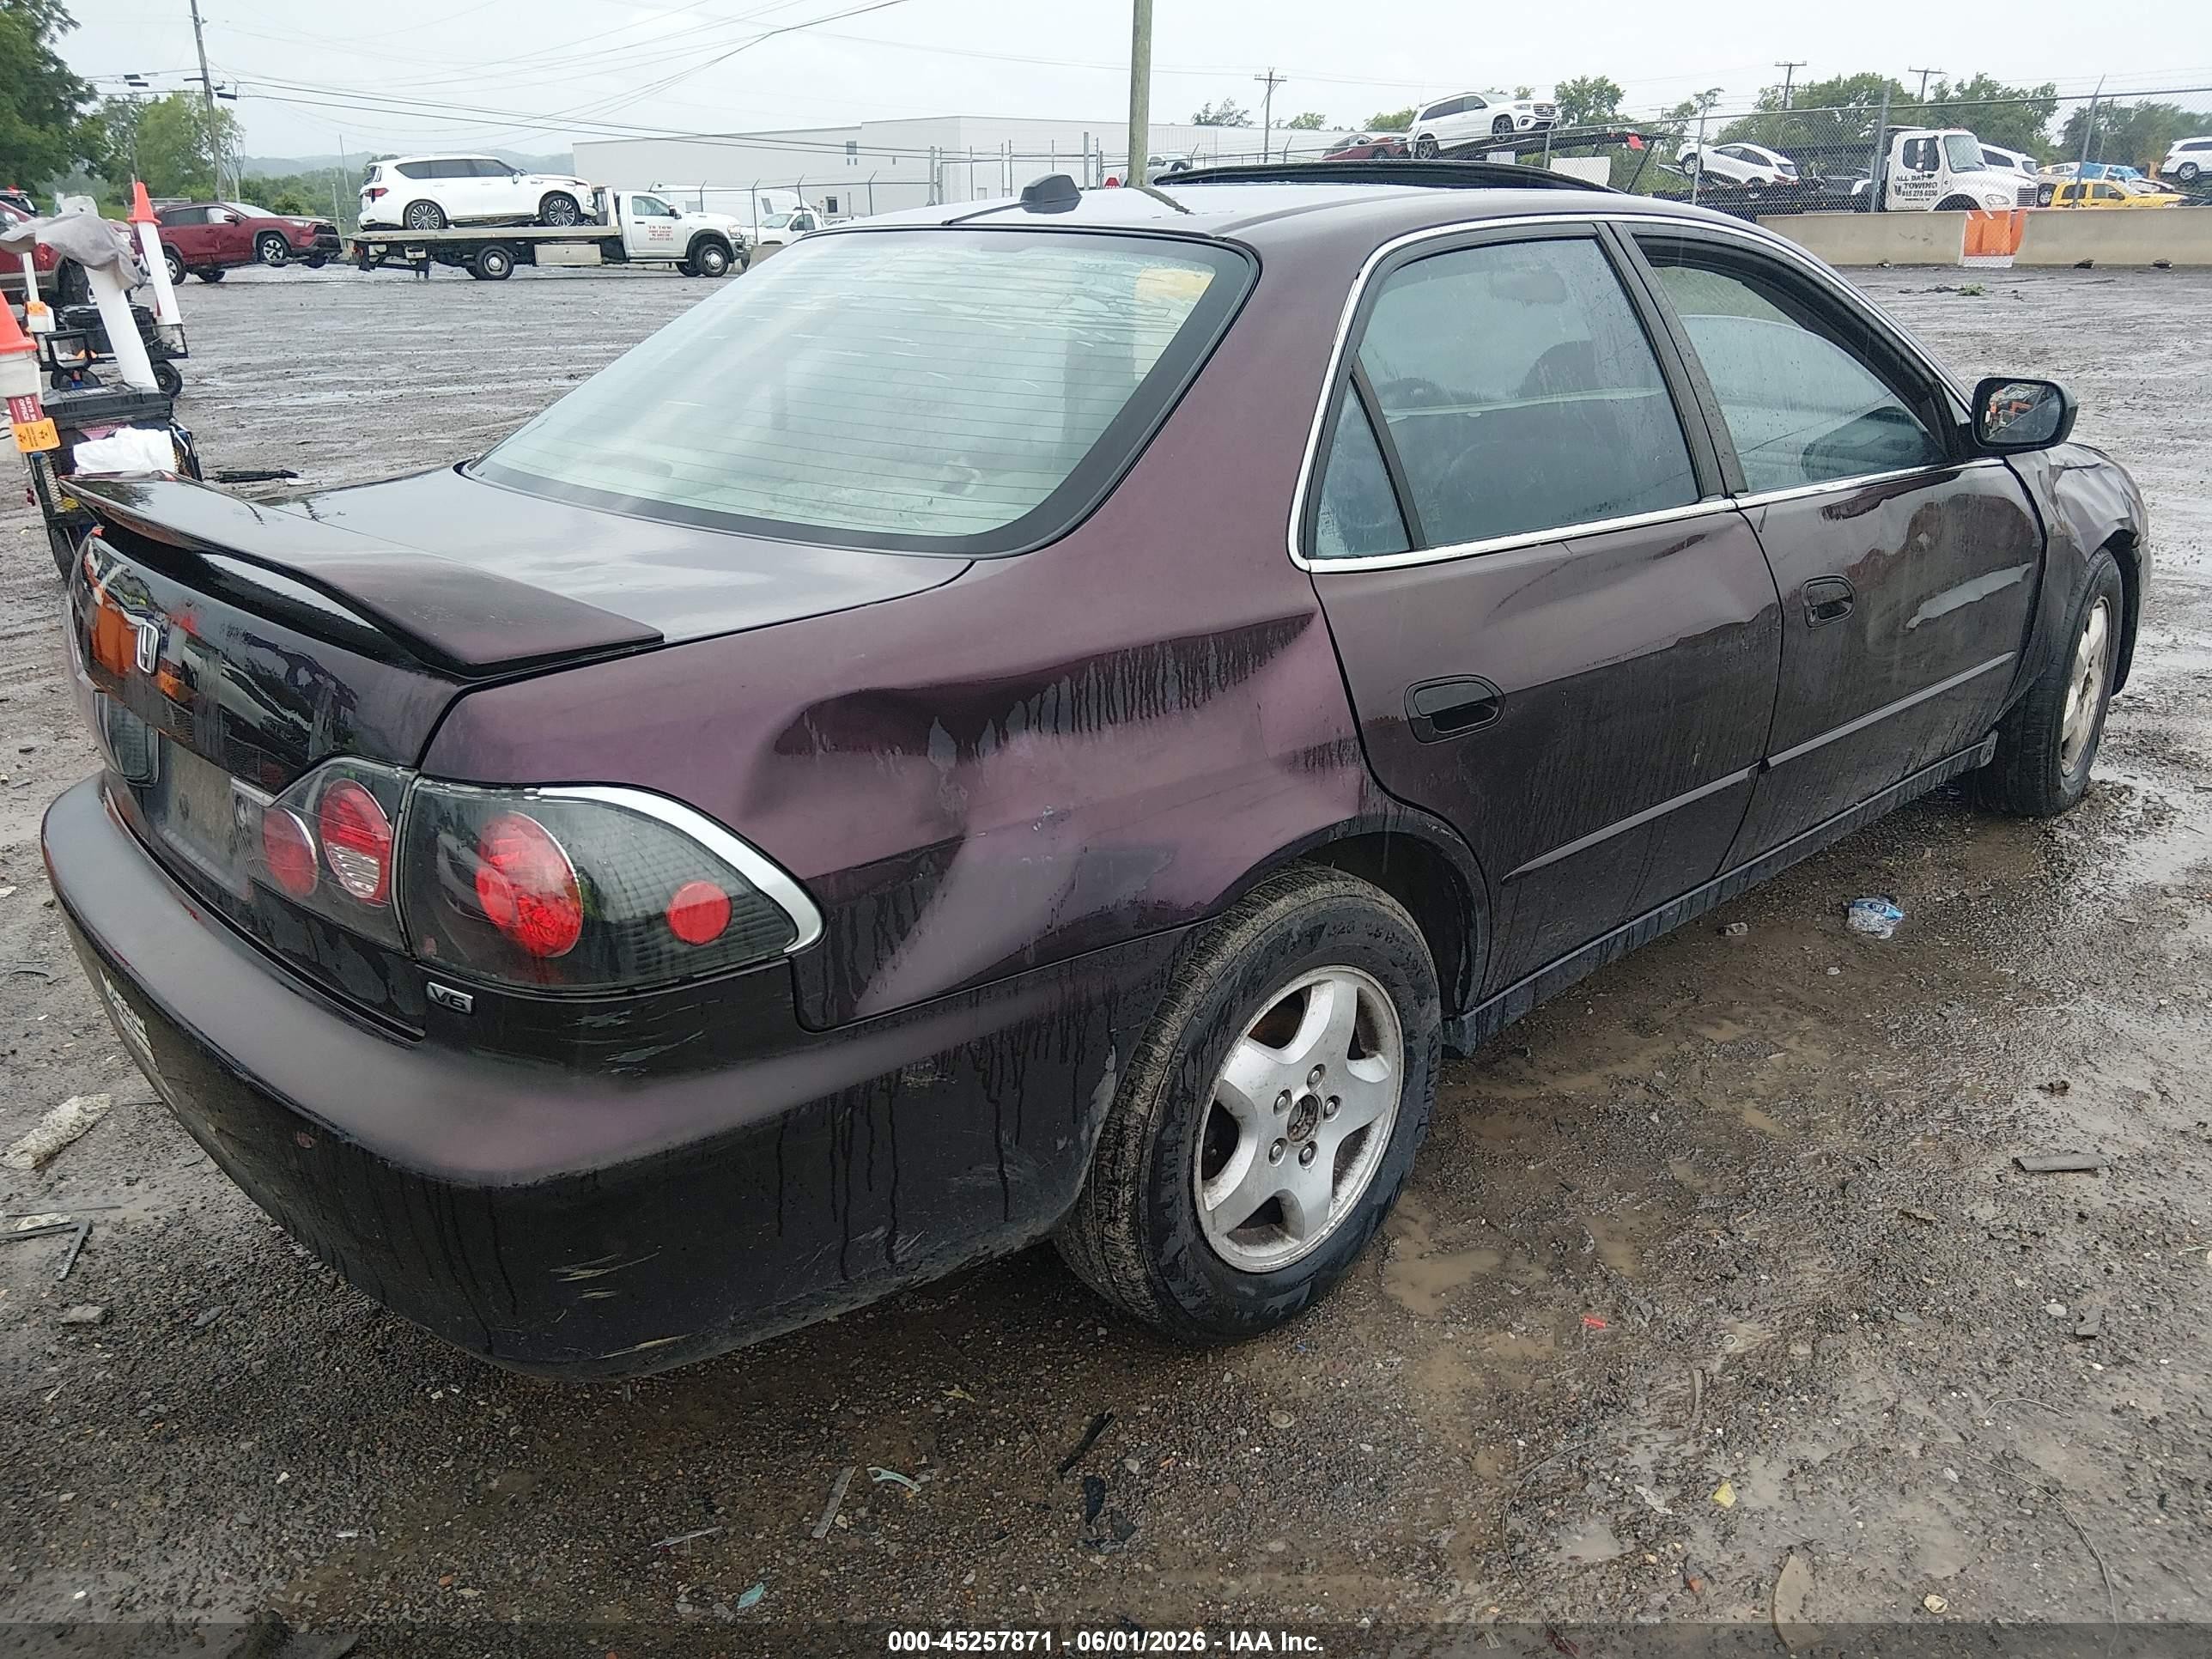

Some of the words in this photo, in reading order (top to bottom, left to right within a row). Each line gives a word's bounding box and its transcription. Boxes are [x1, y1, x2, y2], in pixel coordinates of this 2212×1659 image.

[1902, 181, 1938, 190] TOWING
[19, 398, 30, 421] OFFICE
[428, 983, 468, 1011] V6
